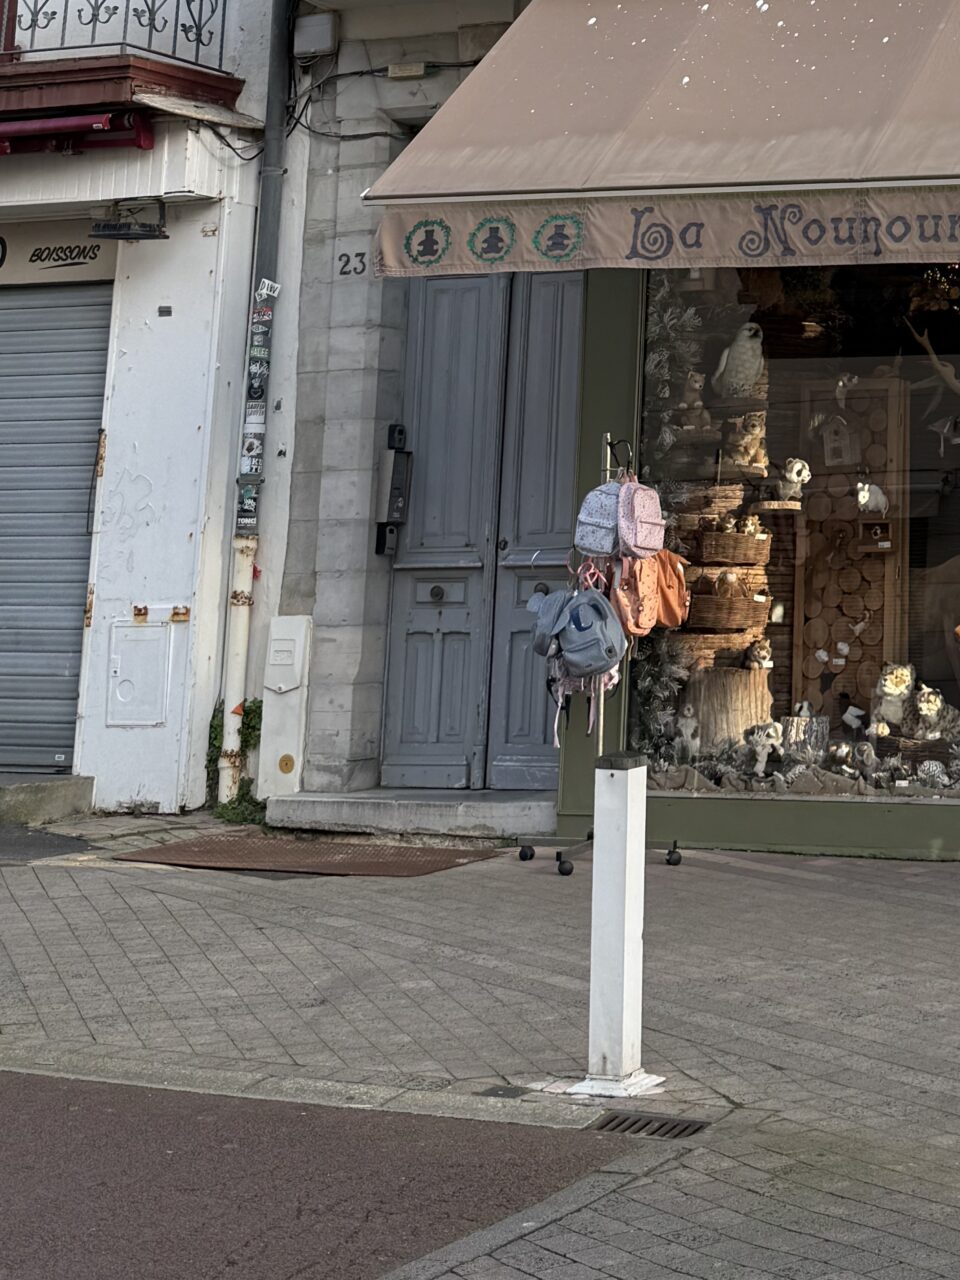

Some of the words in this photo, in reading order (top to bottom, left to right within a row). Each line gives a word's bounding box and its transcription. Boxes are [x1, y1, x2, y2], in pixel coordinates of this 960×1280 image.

[625, 206, 705, 261] La
[29, 244, 100, 263] BOISSONS
[338, 252, 367, 275] 23
